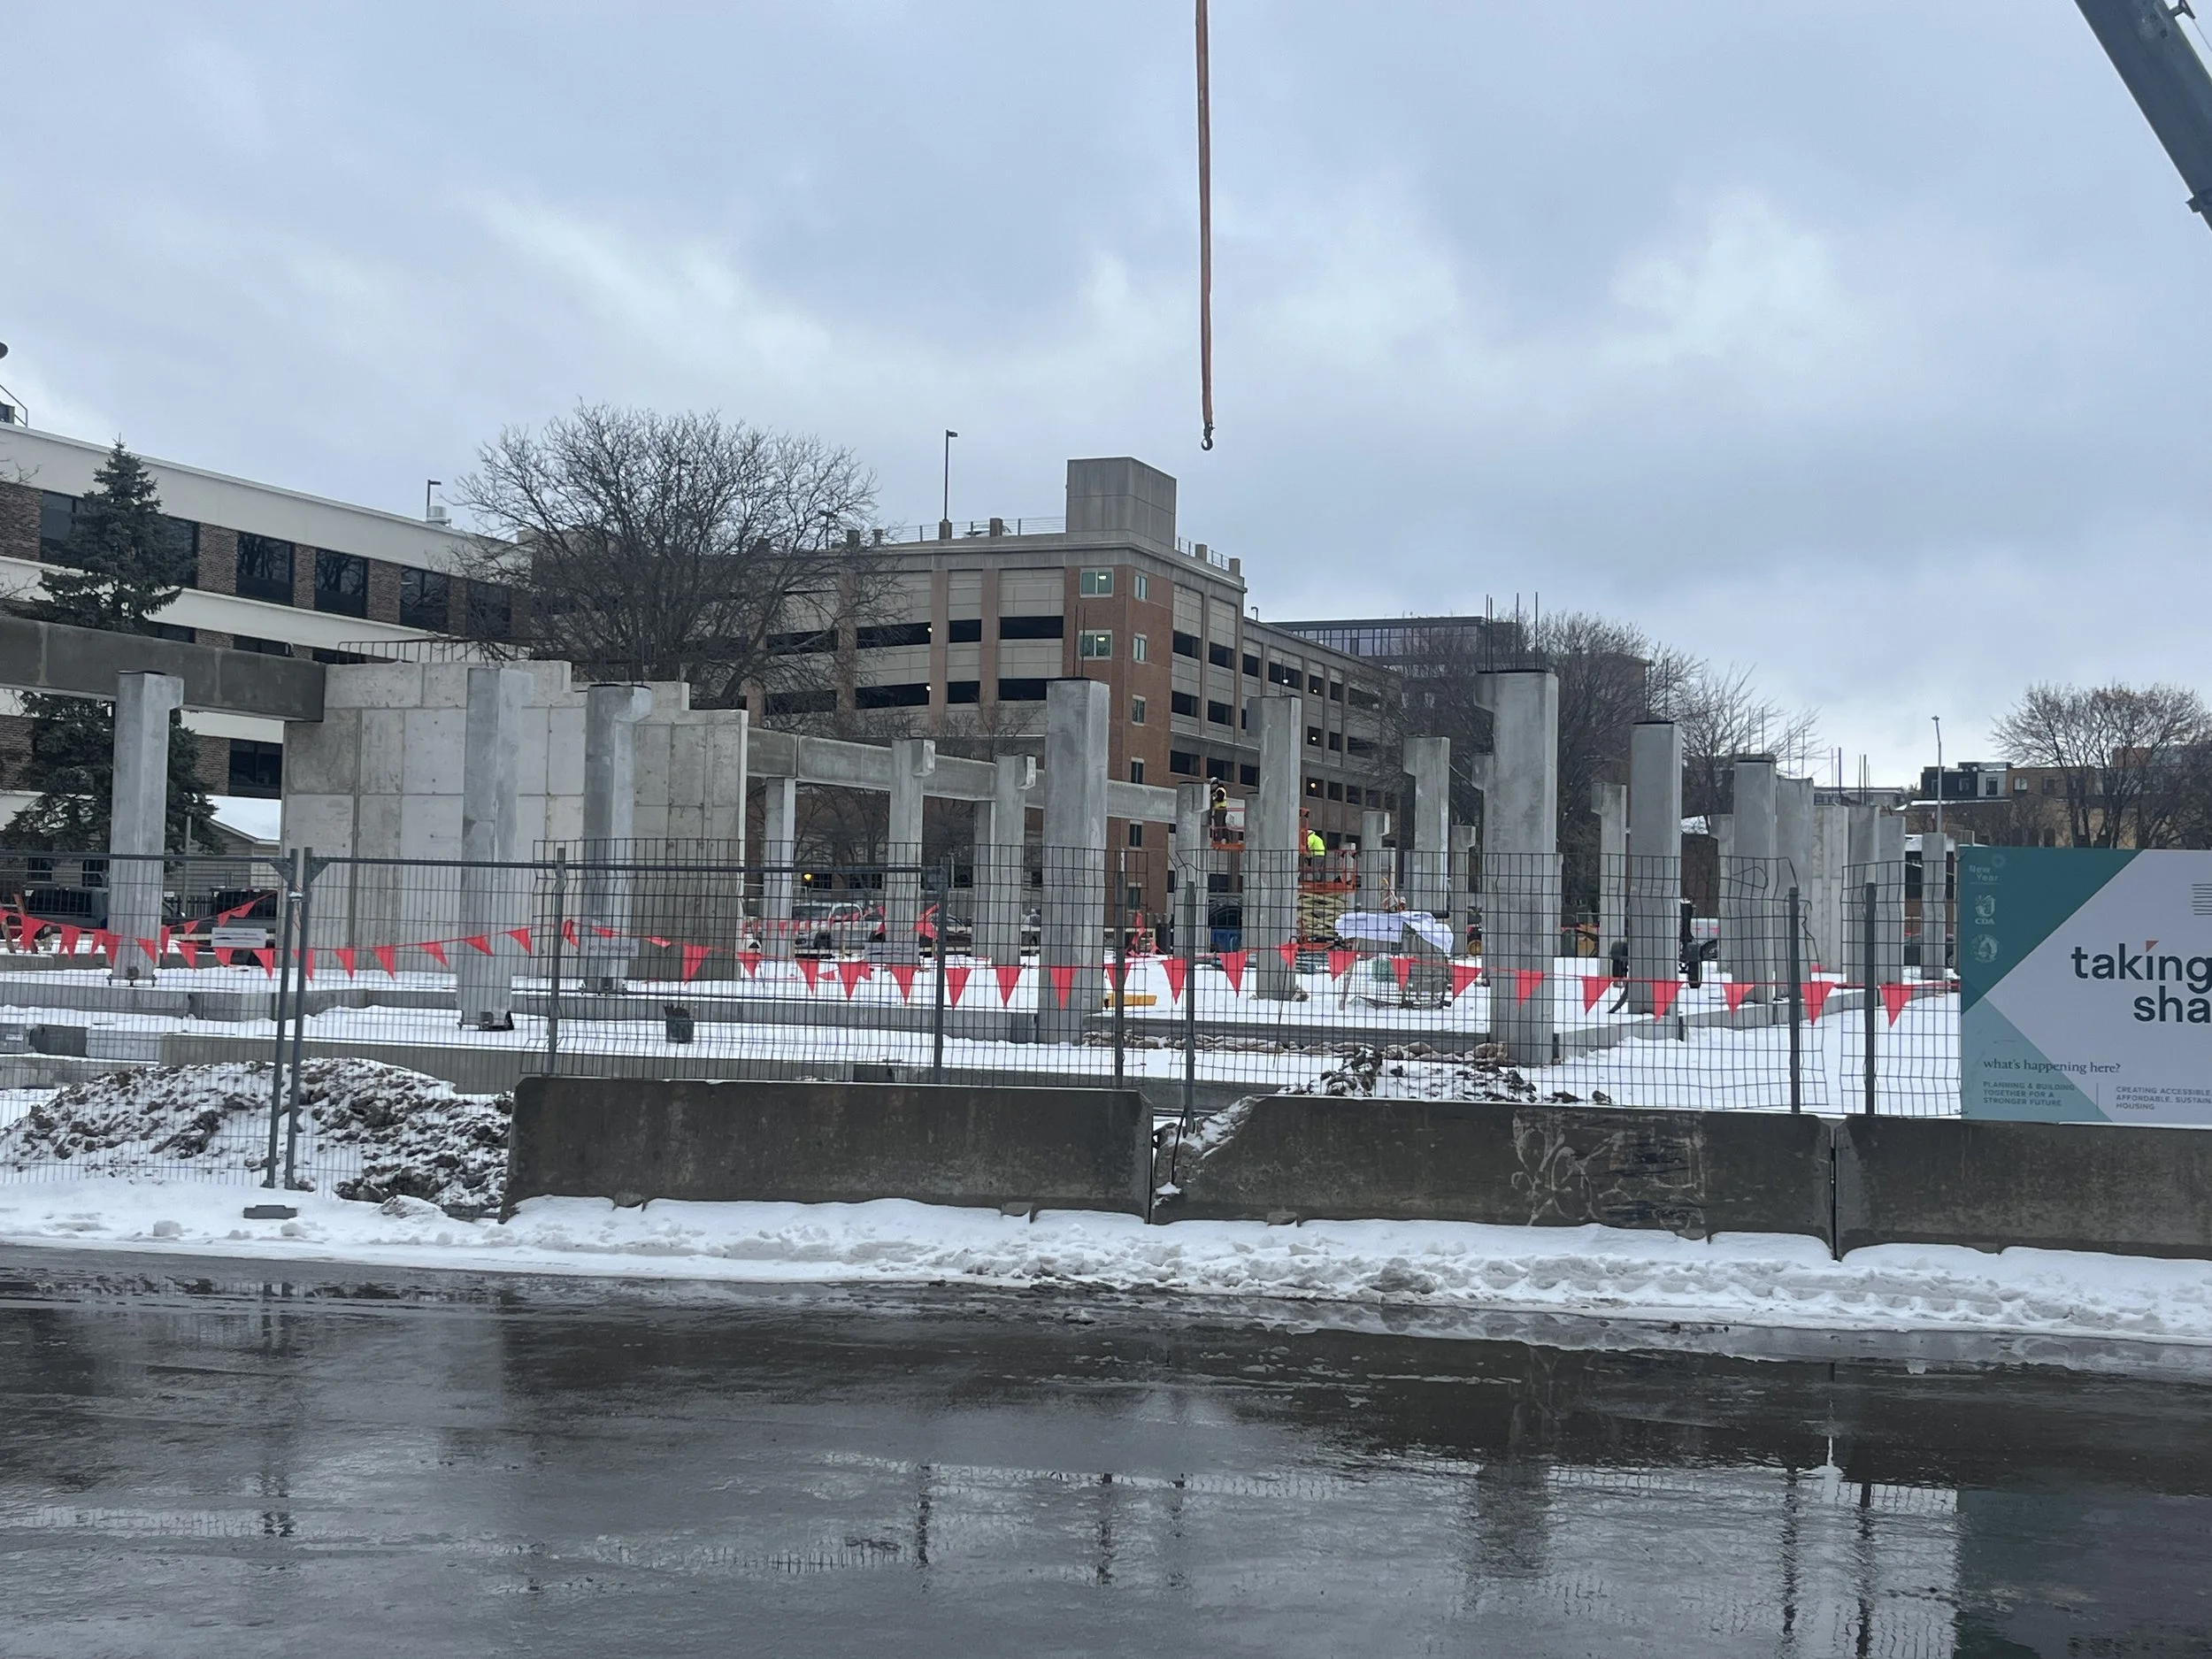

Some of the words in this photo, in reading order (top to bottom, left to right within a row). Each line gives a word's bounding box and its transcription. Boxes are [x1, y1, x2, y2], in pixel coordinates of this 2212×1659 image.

[1969, 864, 1991, 873] New
[1976, 872, 1999, 881] Year
[2070, 941, 2212, 994] taking
[2133, 985, 2211, 1024] sha
[1983, 1058, 2021, 1070] what's
[2024, 1059, 2087, 1075] happening
[2090, 1062, 2121, 1073] here?
[1983, 1080, 2025, 1089] PLANNING
[2116, 1086, 2157, 1094] CREATING
